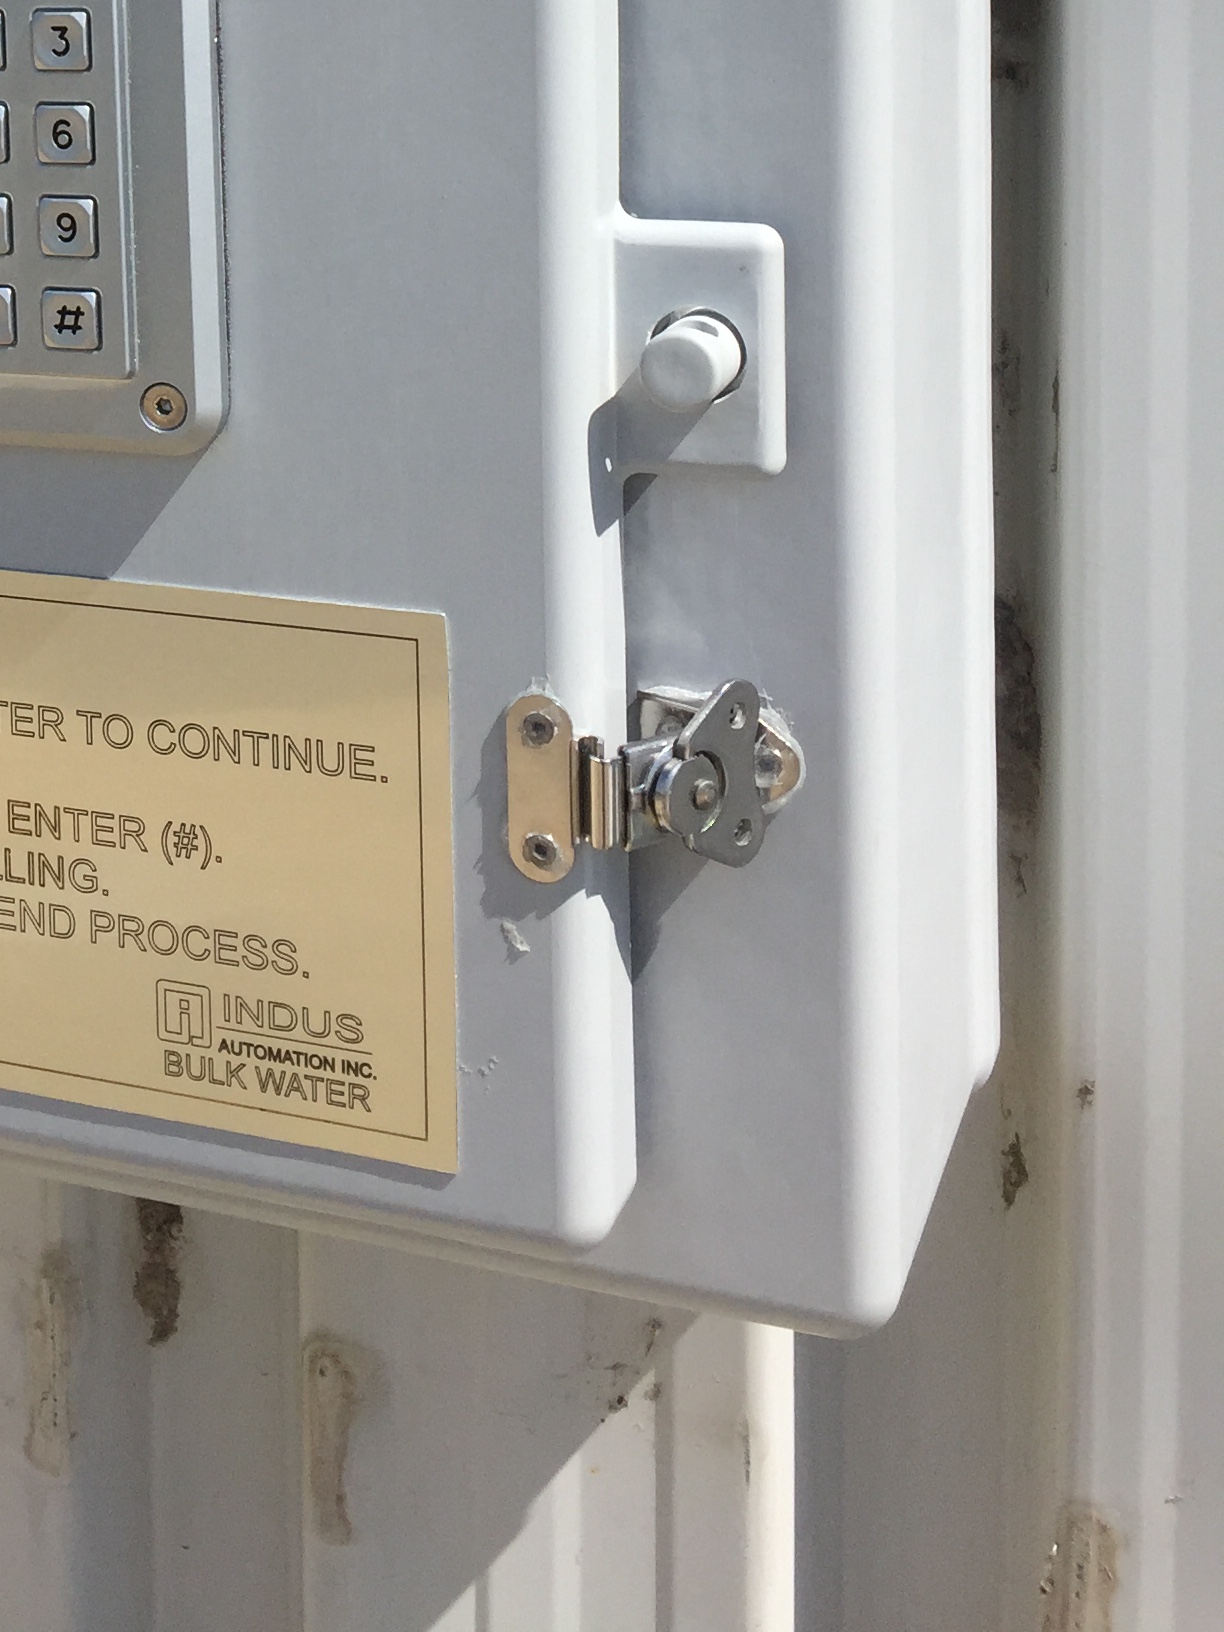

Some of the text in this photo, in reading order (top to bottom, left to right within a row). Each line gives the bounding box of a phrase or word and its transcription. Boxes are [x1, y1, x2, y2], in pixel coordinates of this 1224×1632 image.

[51, 26, 70, 57] 3
[52, 119, 73, 150] 6
[56, 212, 77, 243] 9
[76, 710, 134, 750] TO
[147, 719, 389, 784] CONTINUE.
[7, 801, 148, 852] ENTER
[161, 820, 223, 870] (#).
[89, 909, 311, 979] PROCESS.
[223, 993, 364, 1044] INDUS
[164, 1050, 372, 1113] BULK WATER
[218, 1039, 377, 1081] AUTOMATION INC.
